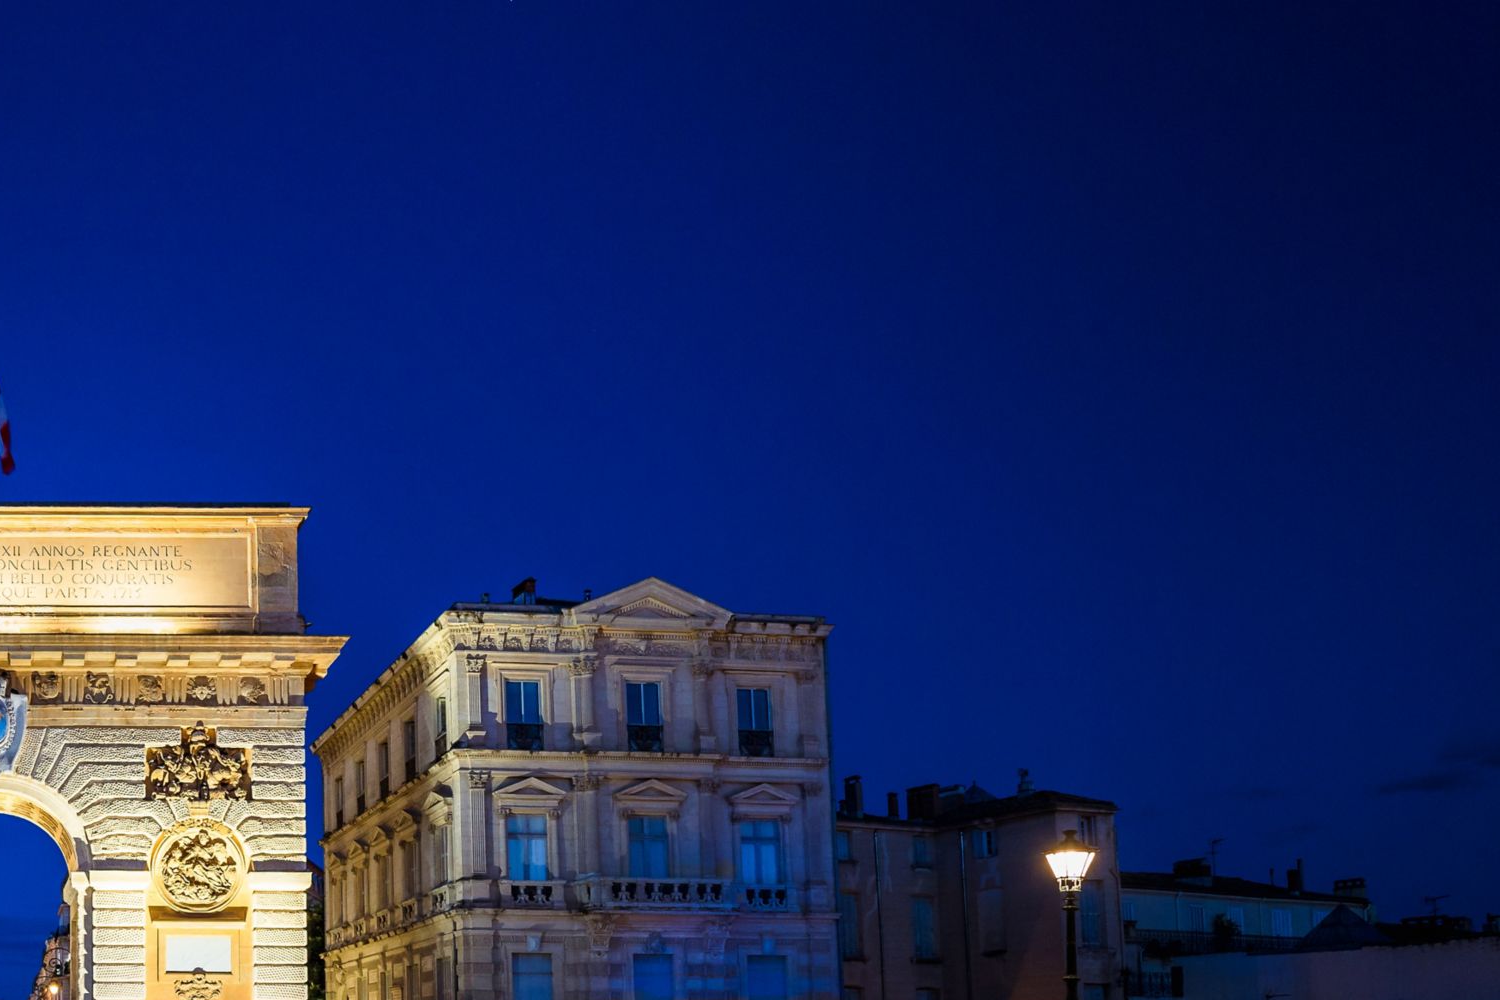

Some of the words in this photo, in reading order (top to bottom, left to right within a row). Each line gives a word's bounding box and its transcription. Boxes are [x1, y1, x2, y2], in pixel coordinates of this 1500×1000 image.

[29, 545, 85, 557] ANNOS
[92, 545, 183, 557] REGNANTE
[102, 559, 192, 571] GENTIBUS
[11, 573, 63, 584] BELLO
[71, 573, 174, 586] CONJURATIS
